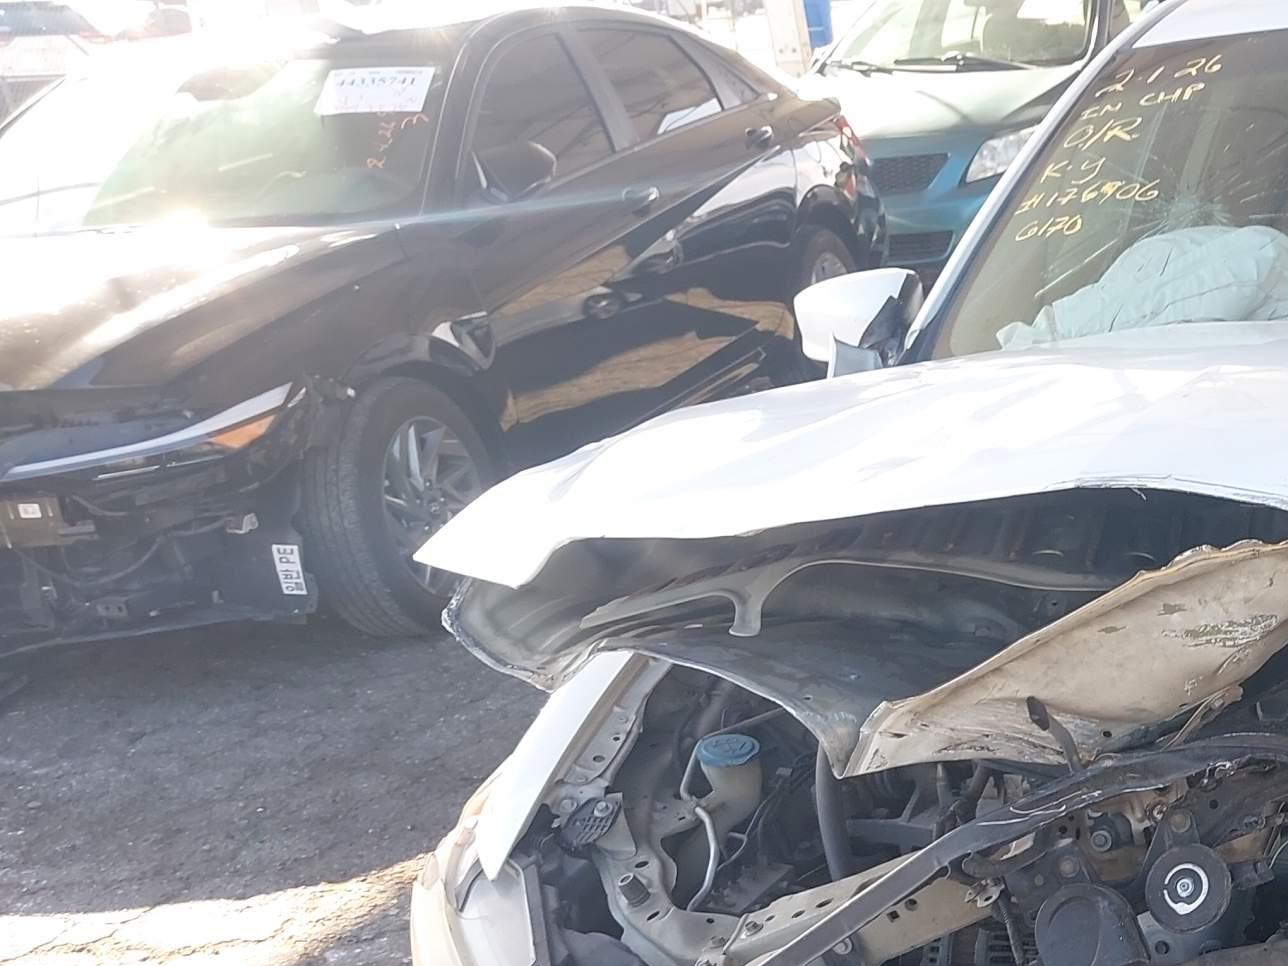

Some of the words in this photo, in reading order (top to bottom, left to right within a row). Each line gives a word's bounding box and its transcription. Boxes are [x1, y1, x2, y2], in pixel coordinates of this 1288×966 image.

[1174, 55, 1223, 78] 26
[1080, 102, 1122, 120] IN
[1139, 82, 1205, 107] CHP
